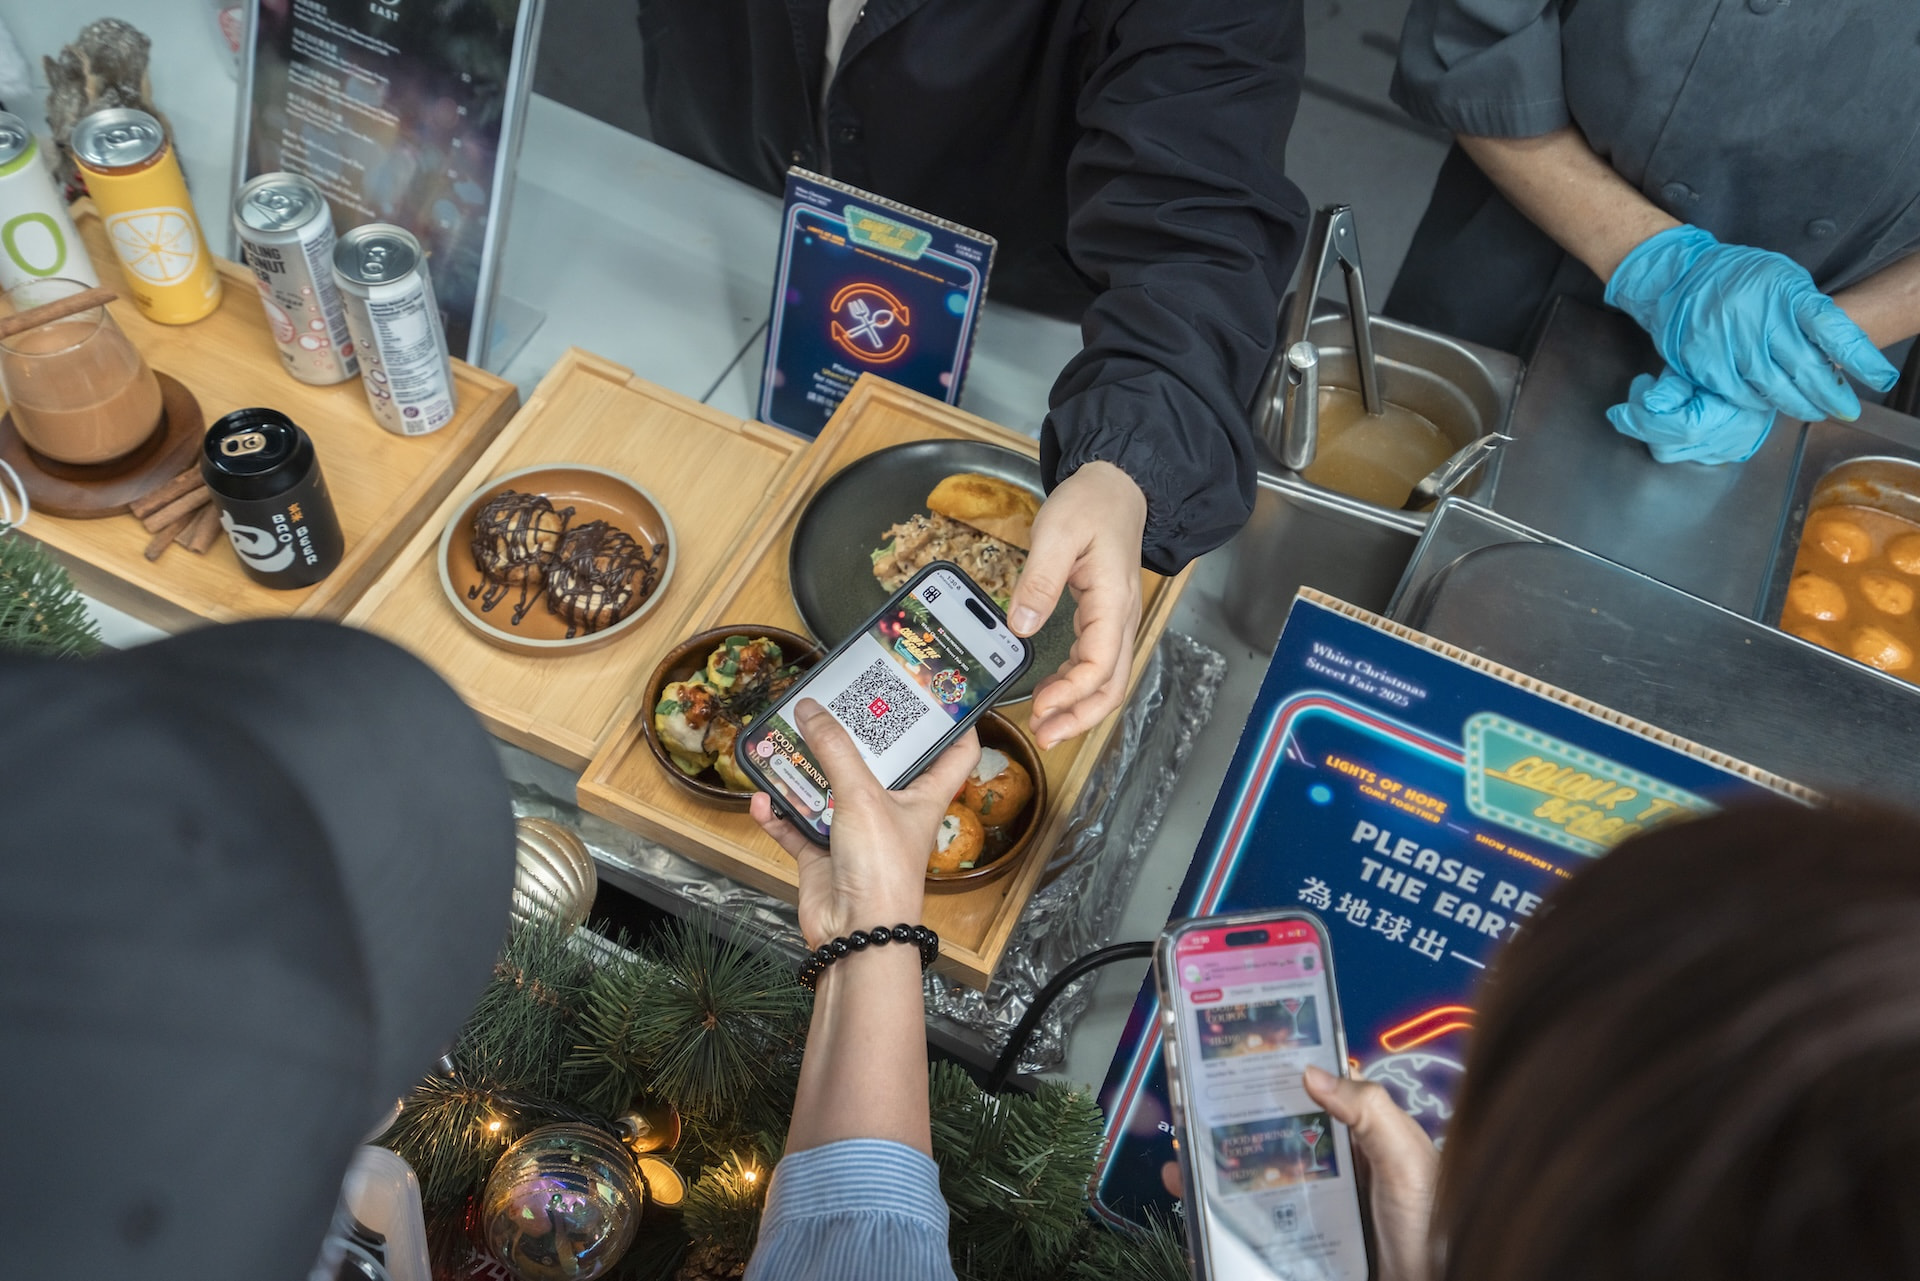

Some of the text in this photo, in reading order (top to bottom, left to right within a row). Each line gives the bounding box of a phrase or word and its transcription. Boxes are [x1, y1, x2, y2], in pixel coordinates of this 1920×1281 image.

[369, 2, 400, 22] EAST
[272, 514, 294, 543] BRO
[295, 525, 318, 566] BEER
[1305, 657, 1411, 709] Street Fair 2025
[1311, 641, 1427, 699] White Christmas
[772, 729, 794, 753] FOOD
[800, 758, 828, 788] DRINKS
[1325, 754, 1449, 814] LIGHTS OF HOPE
[1506, 755, 1638, 812] COLOUR
[1359, 784, 1441, 825] COME TOGETHER
[1350, 819, 1486, 895] PLEASE
[1475, 833, 1506, 851] SHOW
[1506, 847, 1553, 871] SUPPORT
[1296, 876, 1487, 970] 為地球出一
[1359, 856, 1522, 945] THE EART
